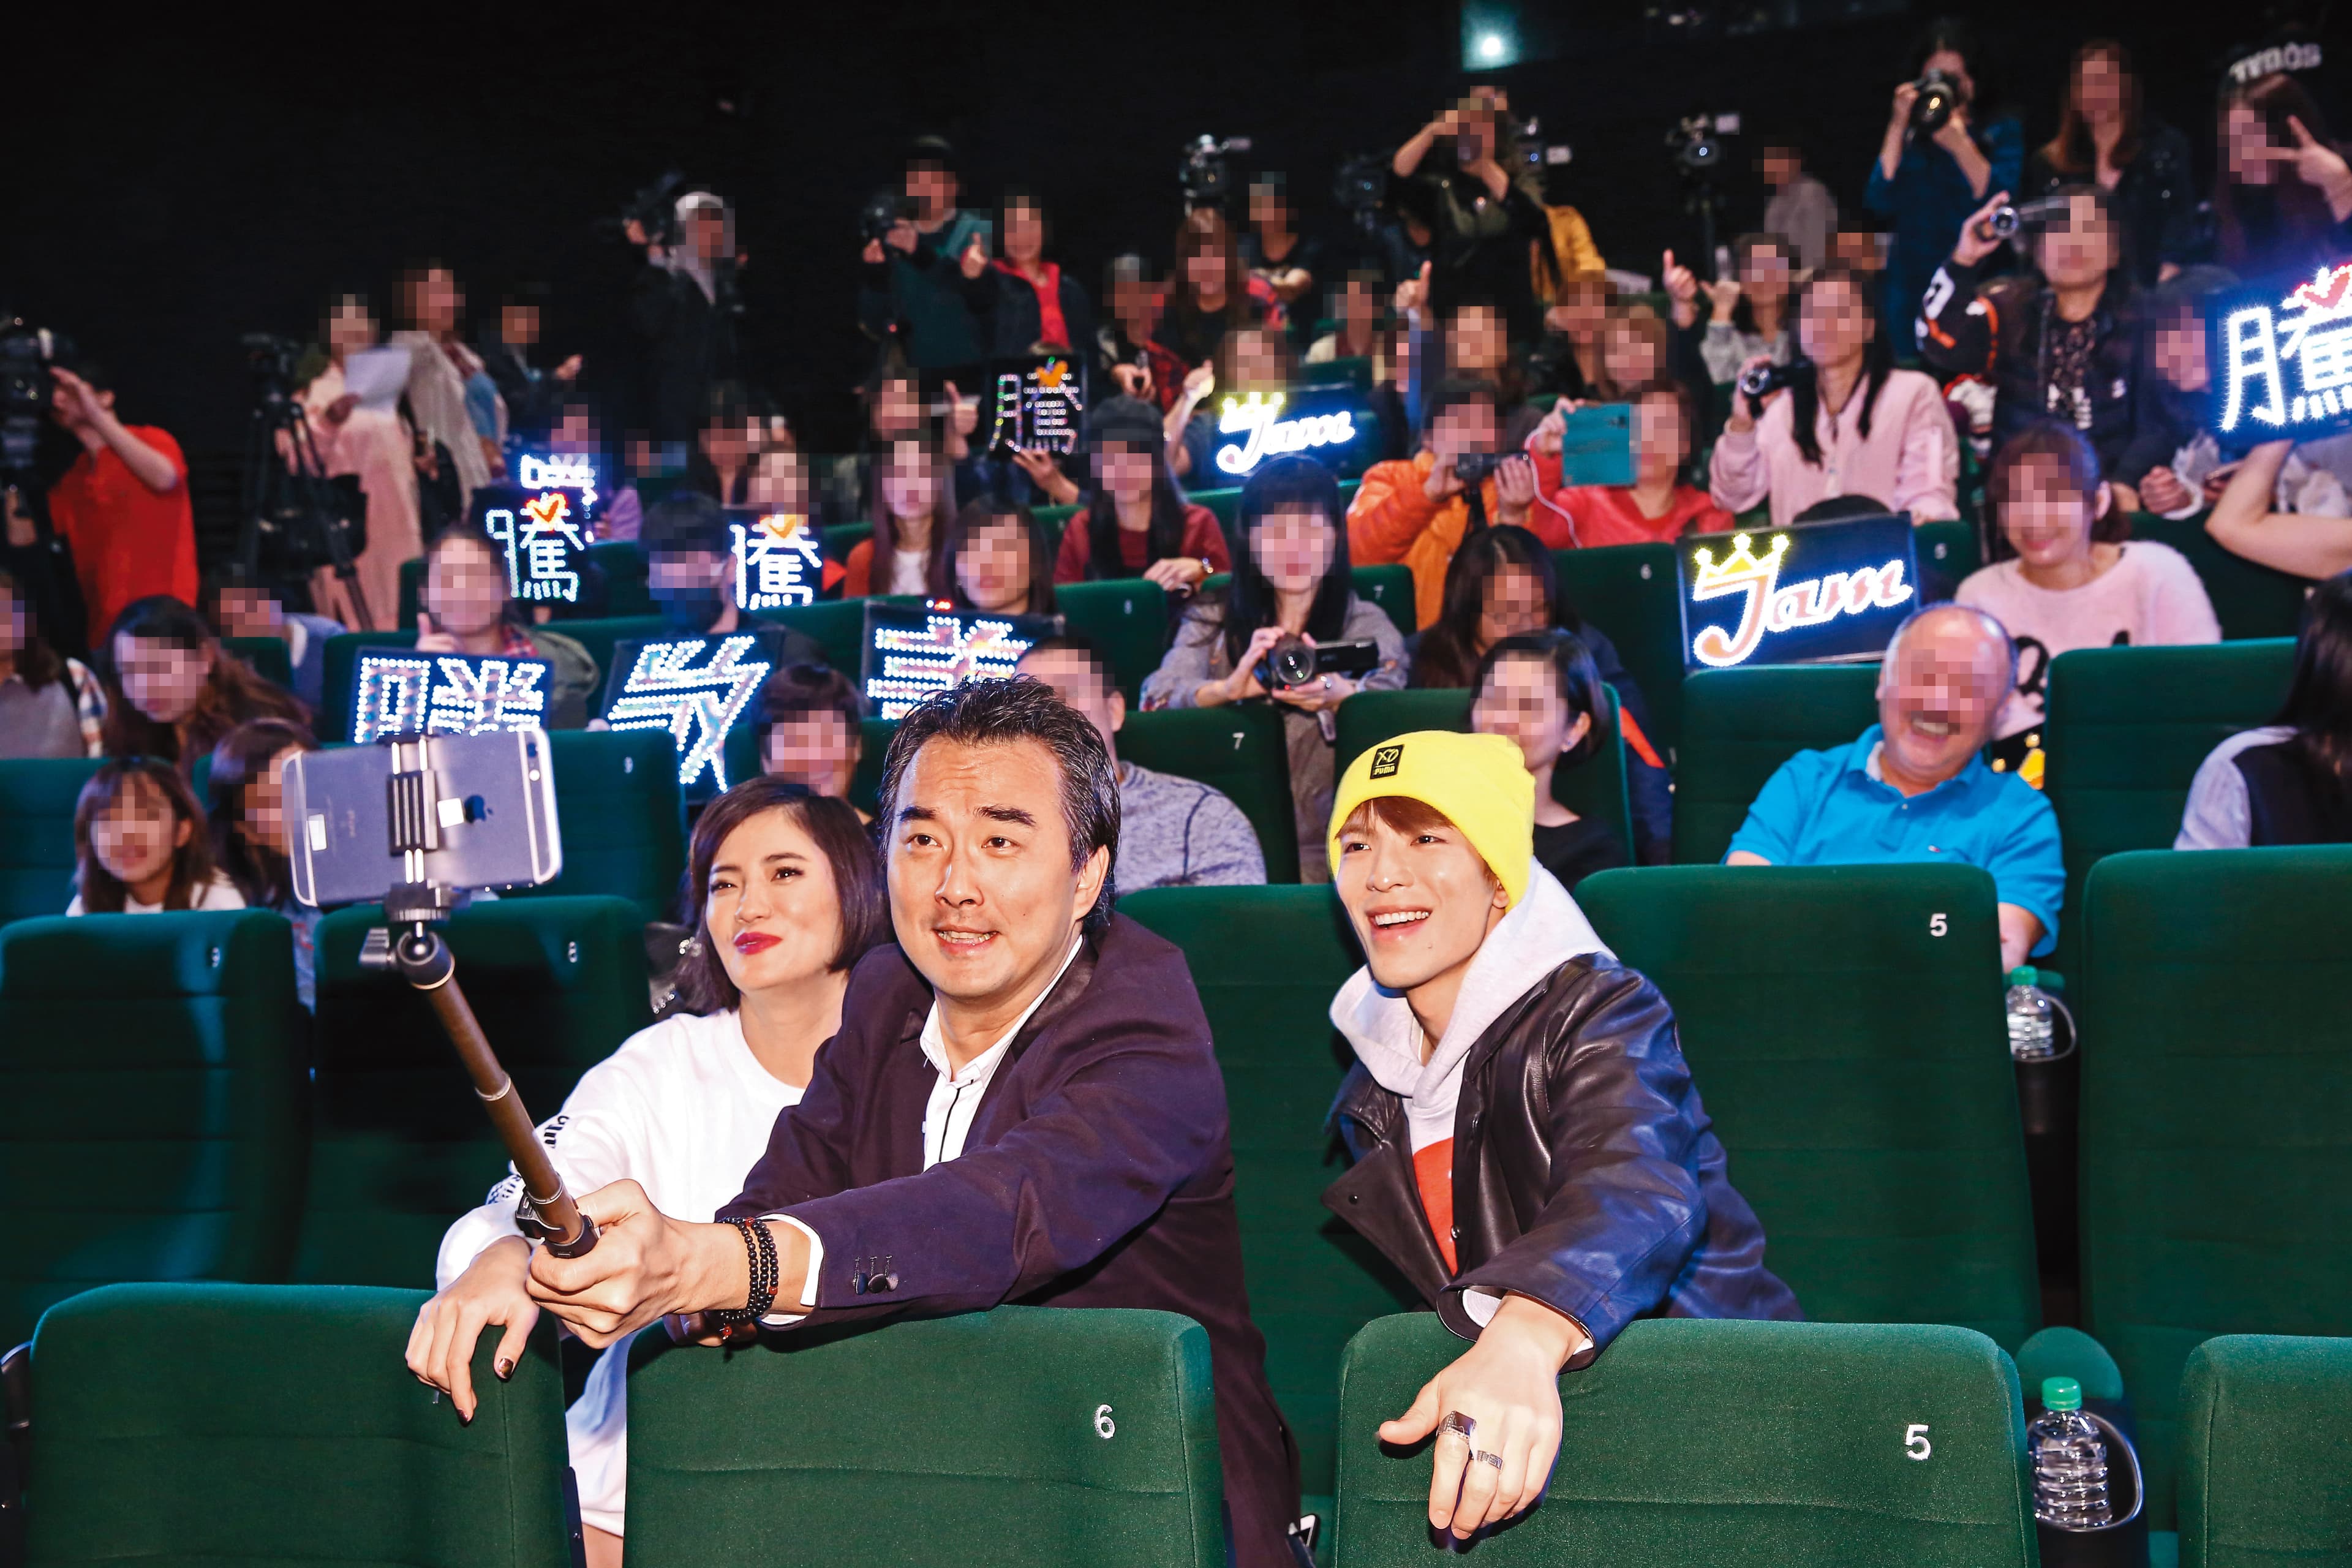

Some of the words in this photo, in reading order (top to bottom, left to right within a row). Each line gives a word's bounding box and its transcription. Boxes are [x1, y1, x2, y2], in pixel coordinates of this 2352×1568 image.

[1692, 554, 1915, 668] Jam
[1232, 731, 1245, 750] 7
[1374, 765, 1395, 775] PUMA
[1929, 913, 1948, 937] 5
[1094, 1403, 1116, 1440] 6
[1904, 1423, 1931, 1461] 5
